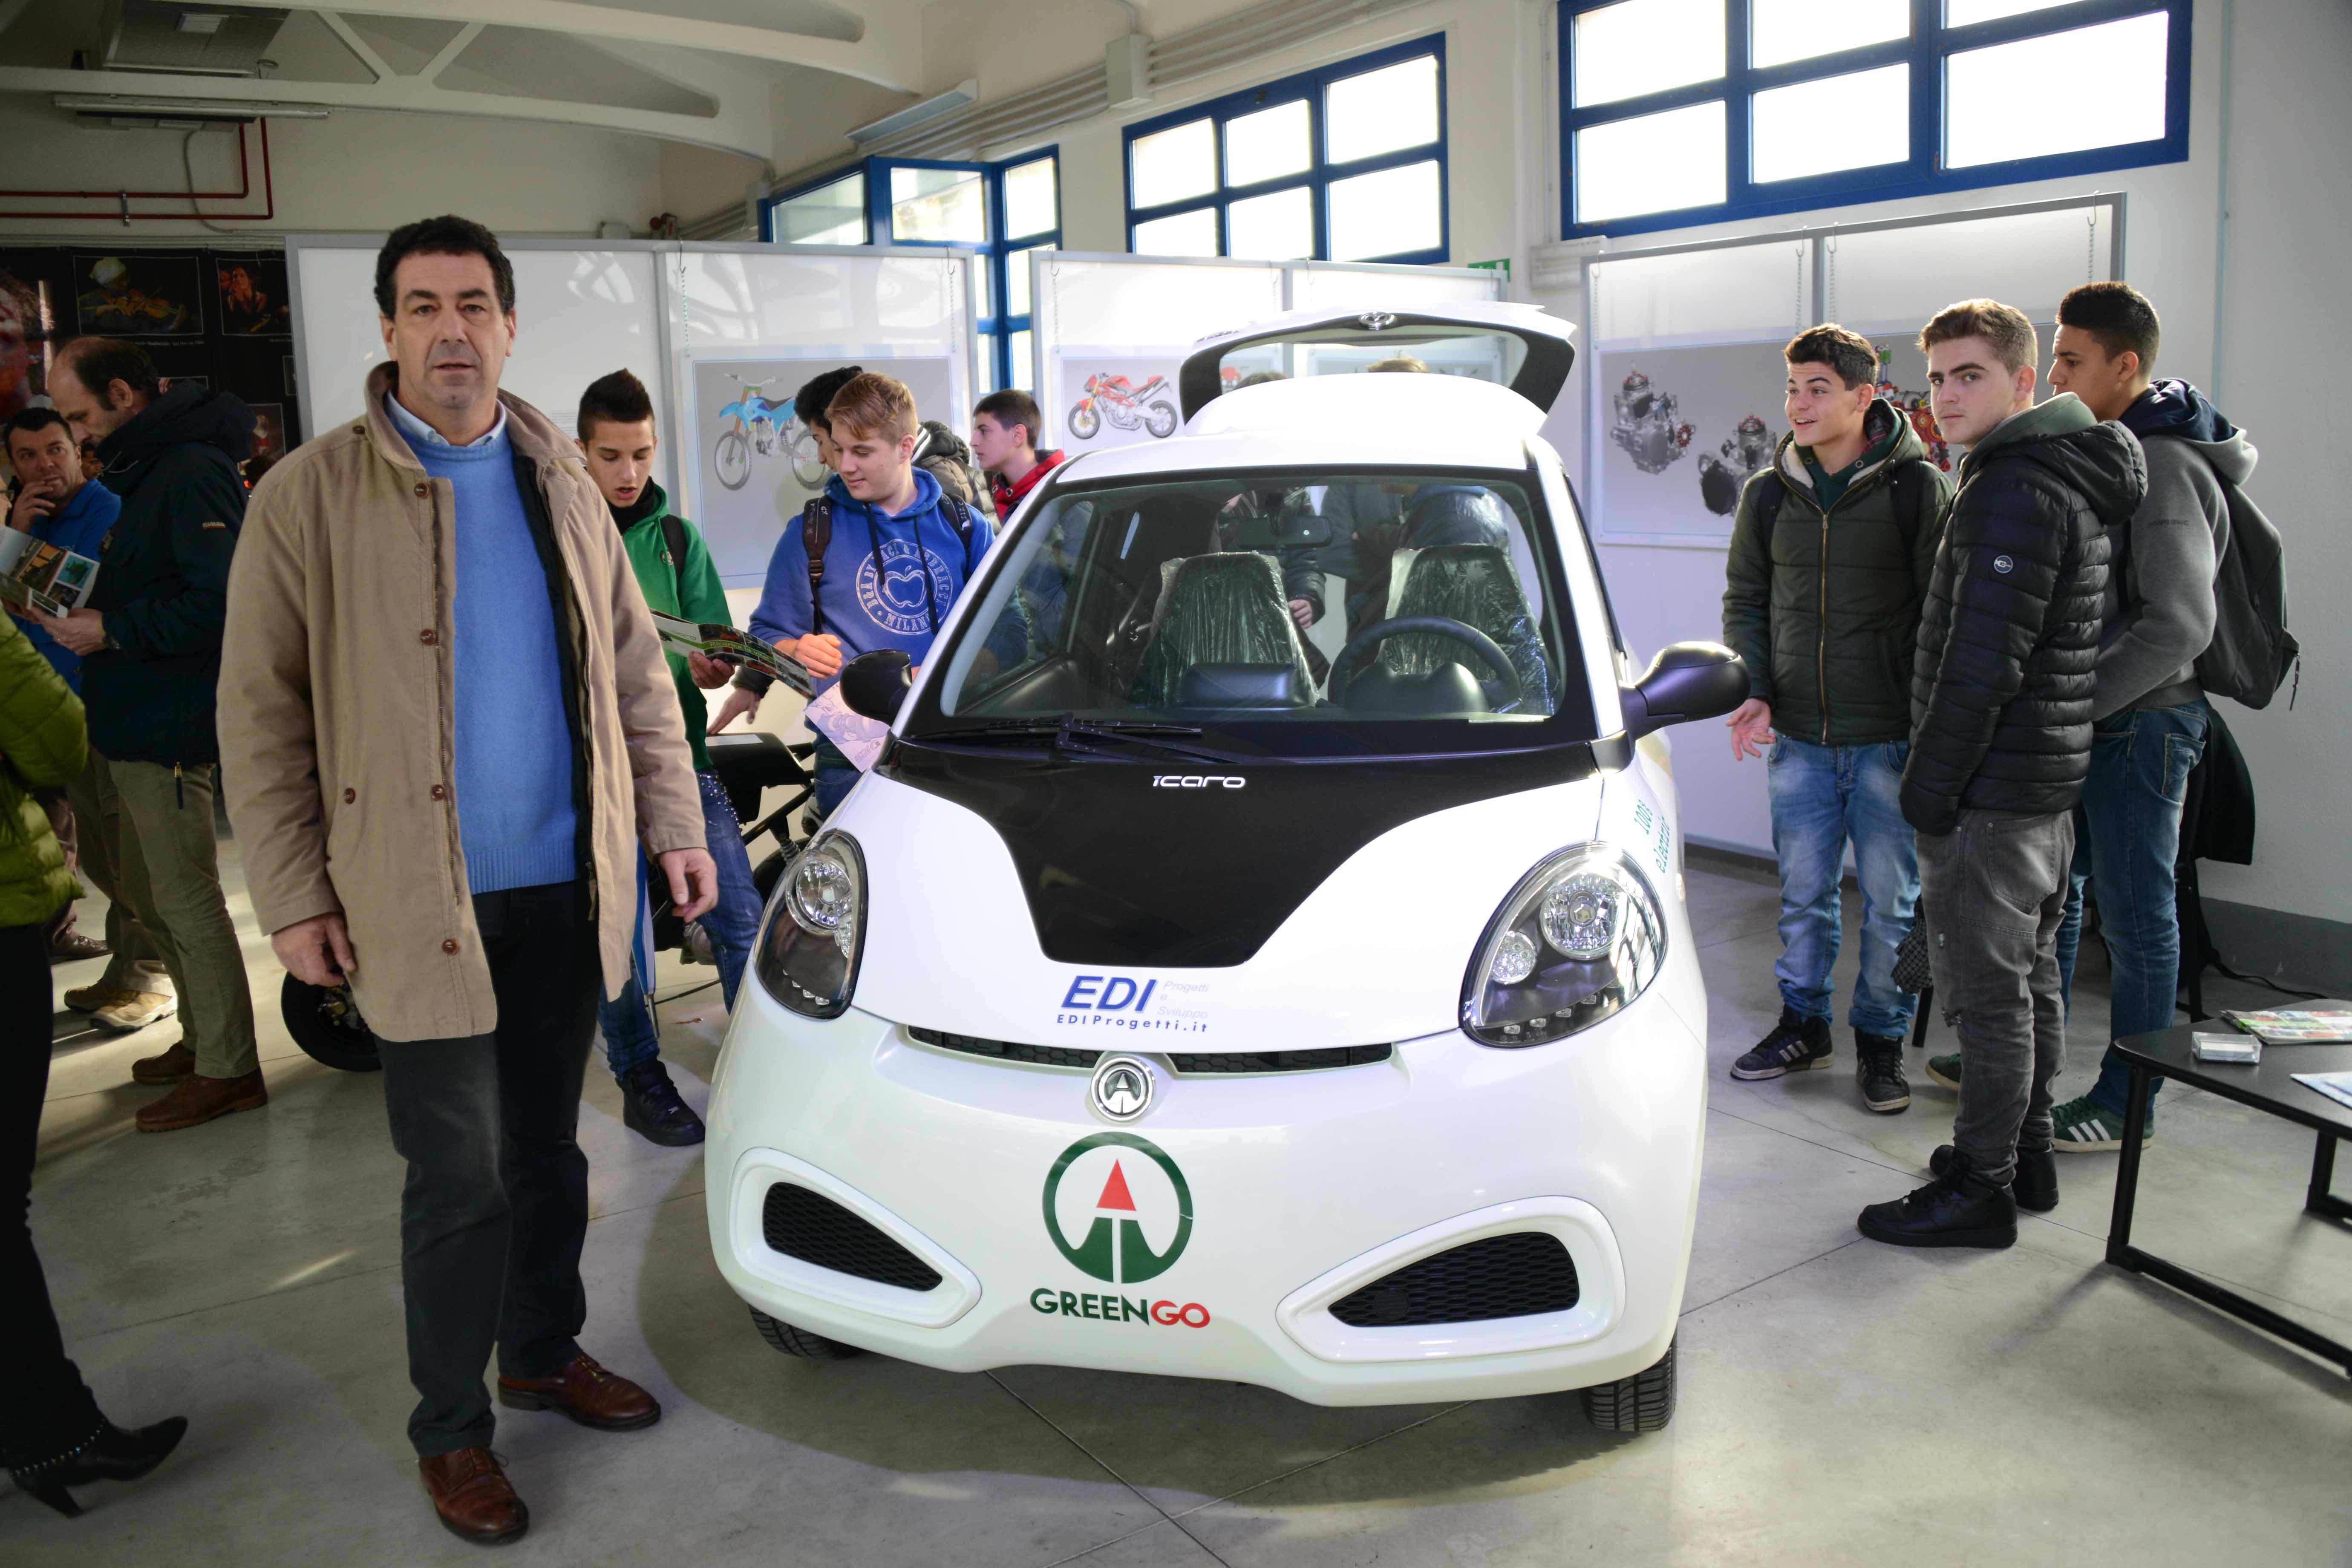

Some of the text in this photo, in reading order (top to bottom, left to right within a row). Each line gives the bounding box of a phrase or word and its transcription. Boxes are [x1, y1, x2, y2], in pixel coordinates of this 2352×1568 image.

[864, 564, 876, 578] BY
[870, 543, 899, 561] ACI
[1152, 775, 1246, 788] icaro
[1653, 815, 1670, 873] electric
[1061, 975, 1159, 1013] EDI
[1163, 981, 1211, 992] Progetti
[1157, 1006, 1208, 1019] Sviluppo
[1057, 1014, 1208, 1032] EDIProgetti.it
